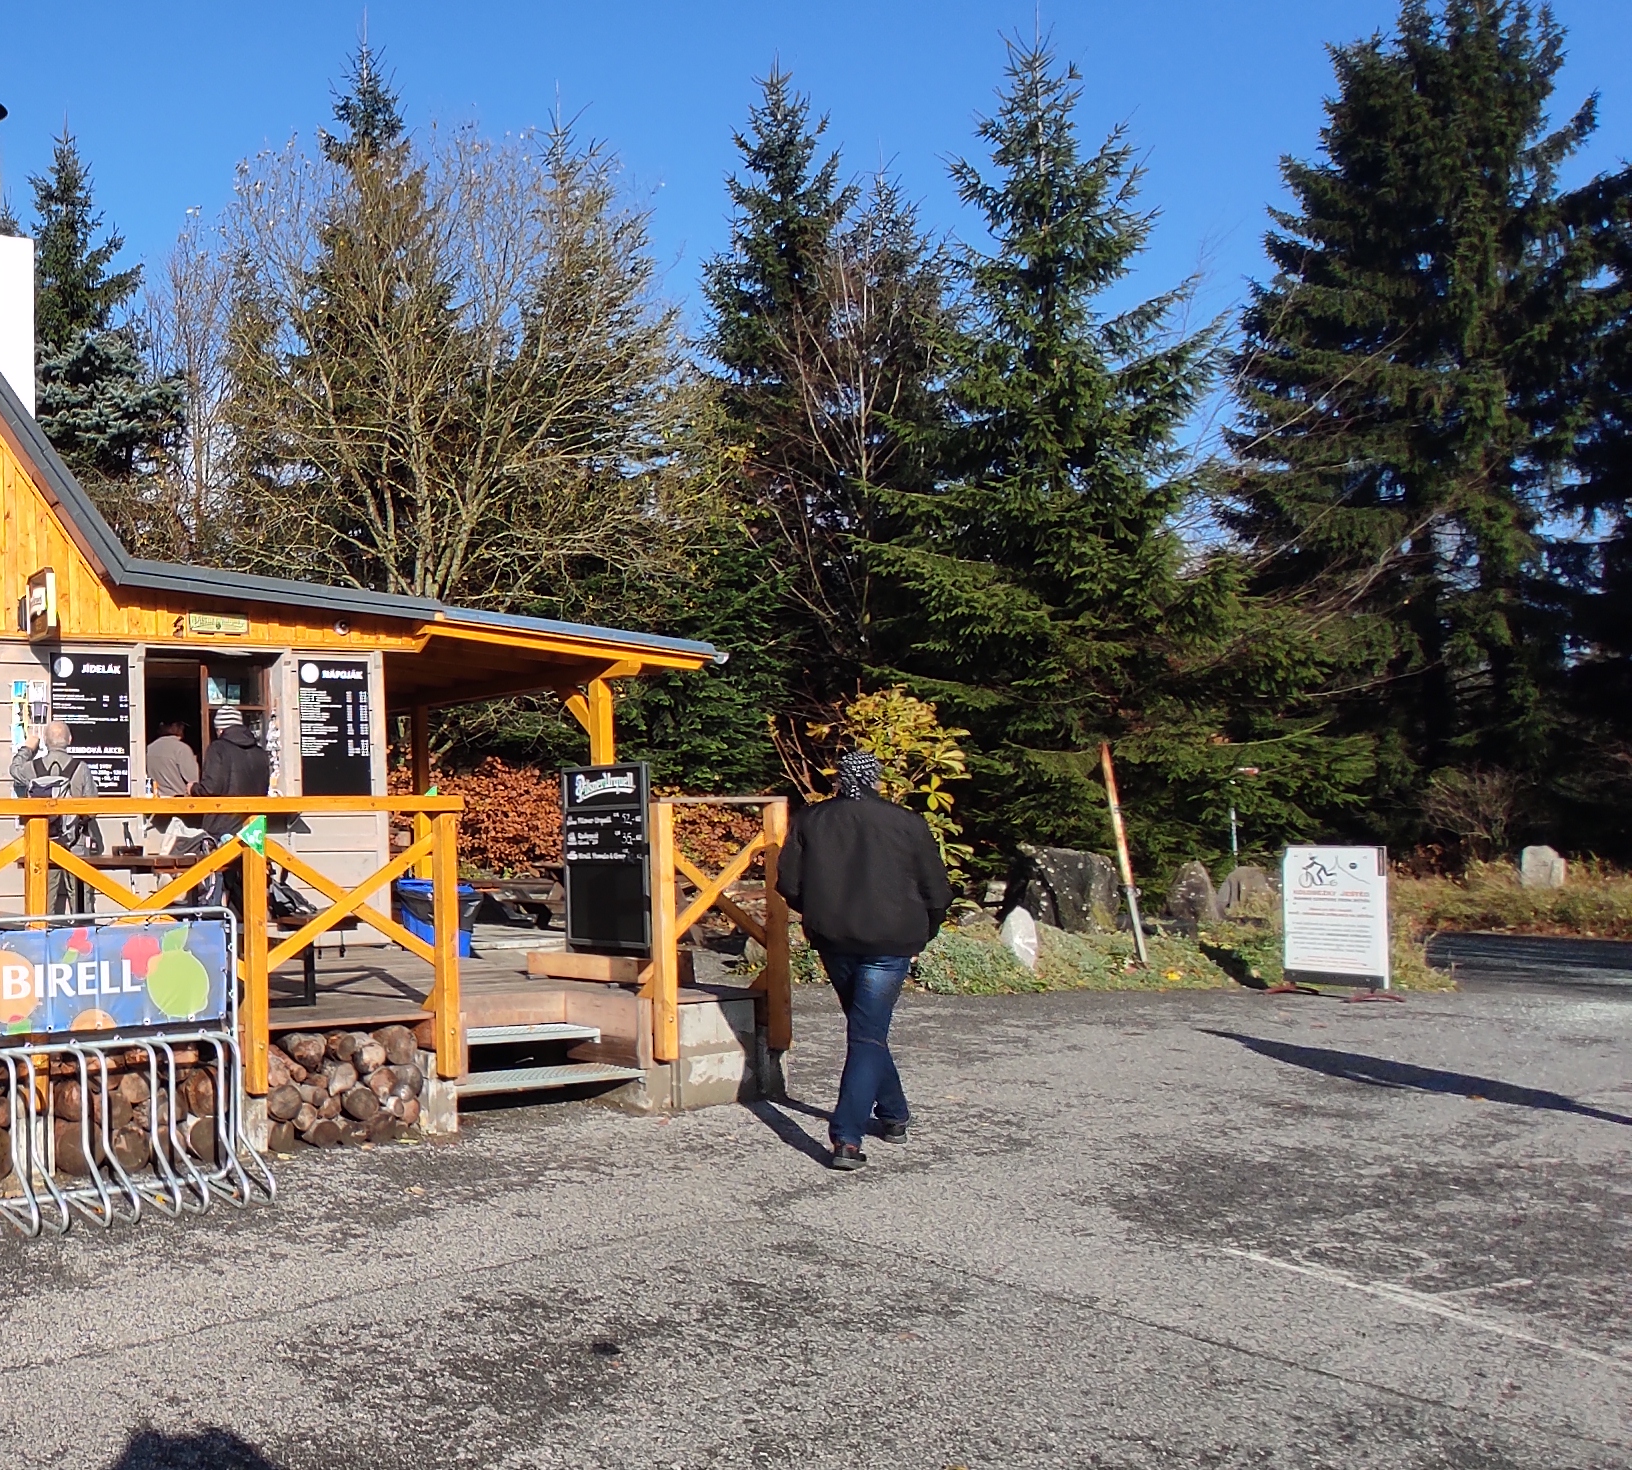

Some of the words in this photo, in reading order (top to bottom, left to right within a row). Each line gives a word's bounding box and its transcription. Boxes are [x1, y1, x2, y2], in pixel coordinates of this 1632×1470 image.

[81, 662, 121, 674] JÍDELÁK
[575, 774, 605, 803] Pilsner
[602, 771, 636, 794] Urquell
[2, 959, 142, 1000] BIRELL
